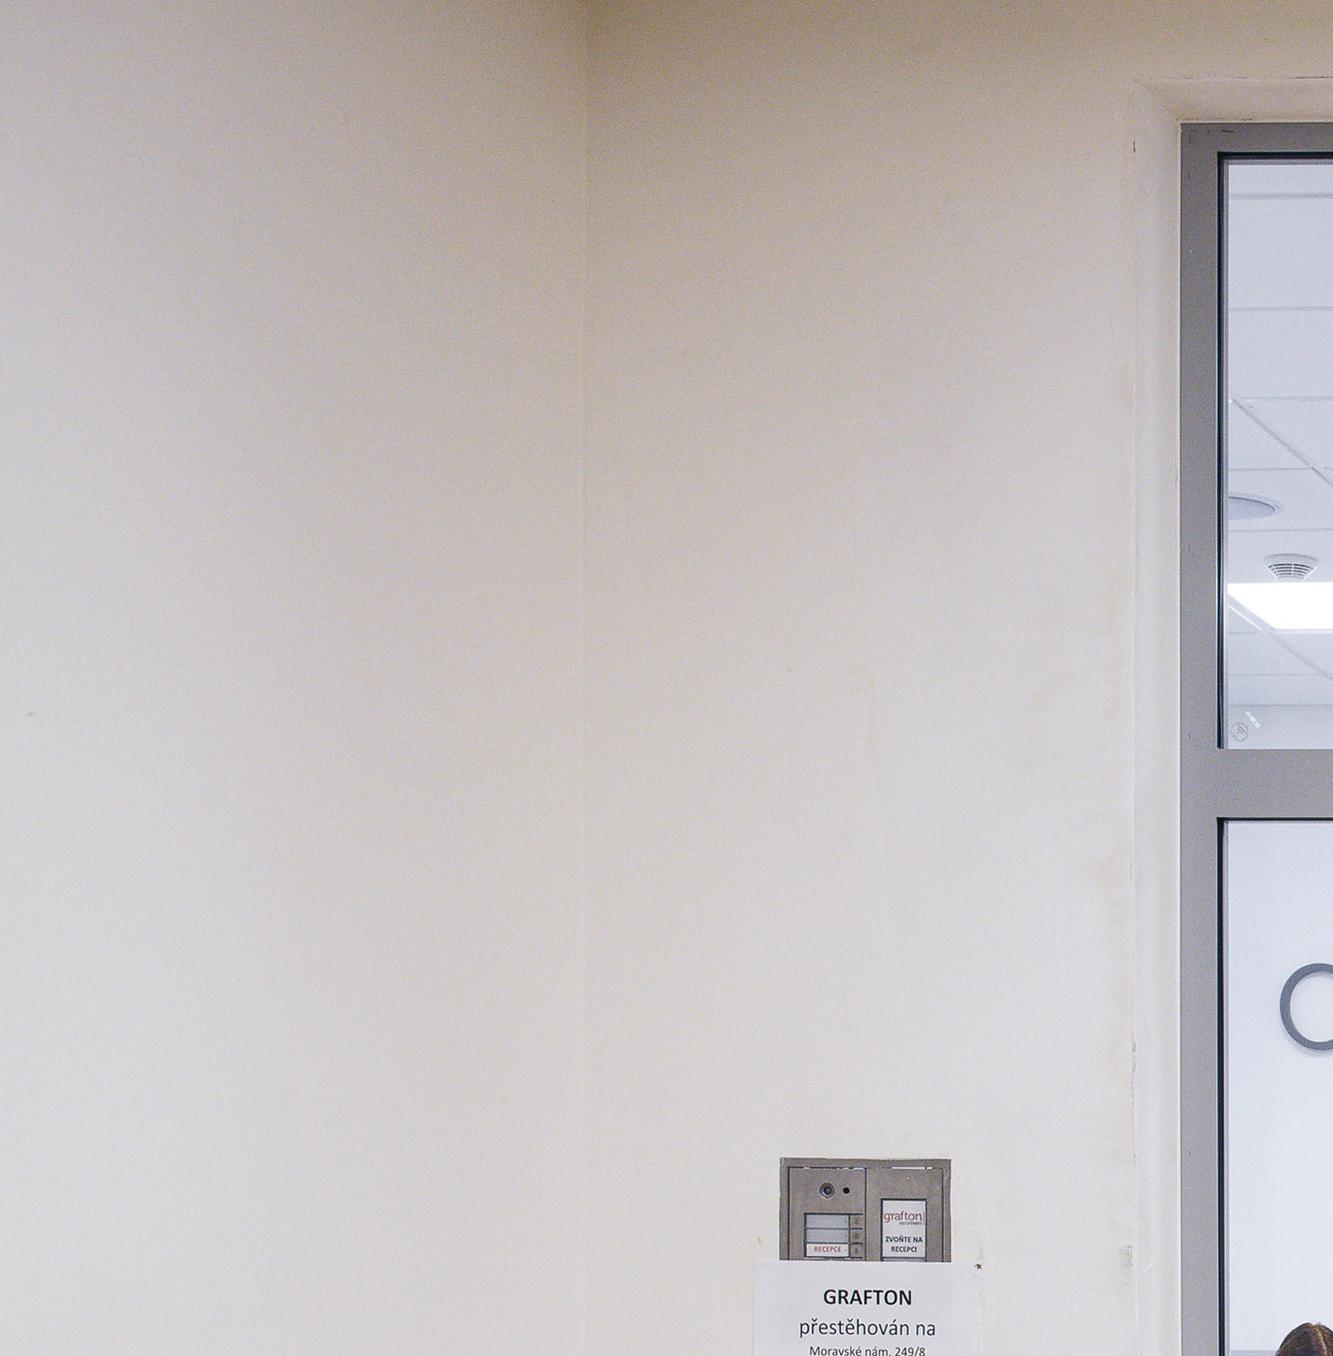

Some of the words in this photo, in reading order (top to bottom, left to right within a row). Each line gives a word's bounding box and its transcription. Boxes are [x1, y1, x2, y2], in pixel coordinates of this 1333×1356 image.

[884, 1211, 922, 1223] grafton
[885, 1235, 911, 1243] ZVOŇTE
[823, 1289, 912, 1305] GRAFTON
[800, 1318, 909, 1338] přestěhován
[915, 1322, 936, 1336] na
[809, 1346, 862, 1356] Moravské
[865, 1347, 891, 1356] nám.
